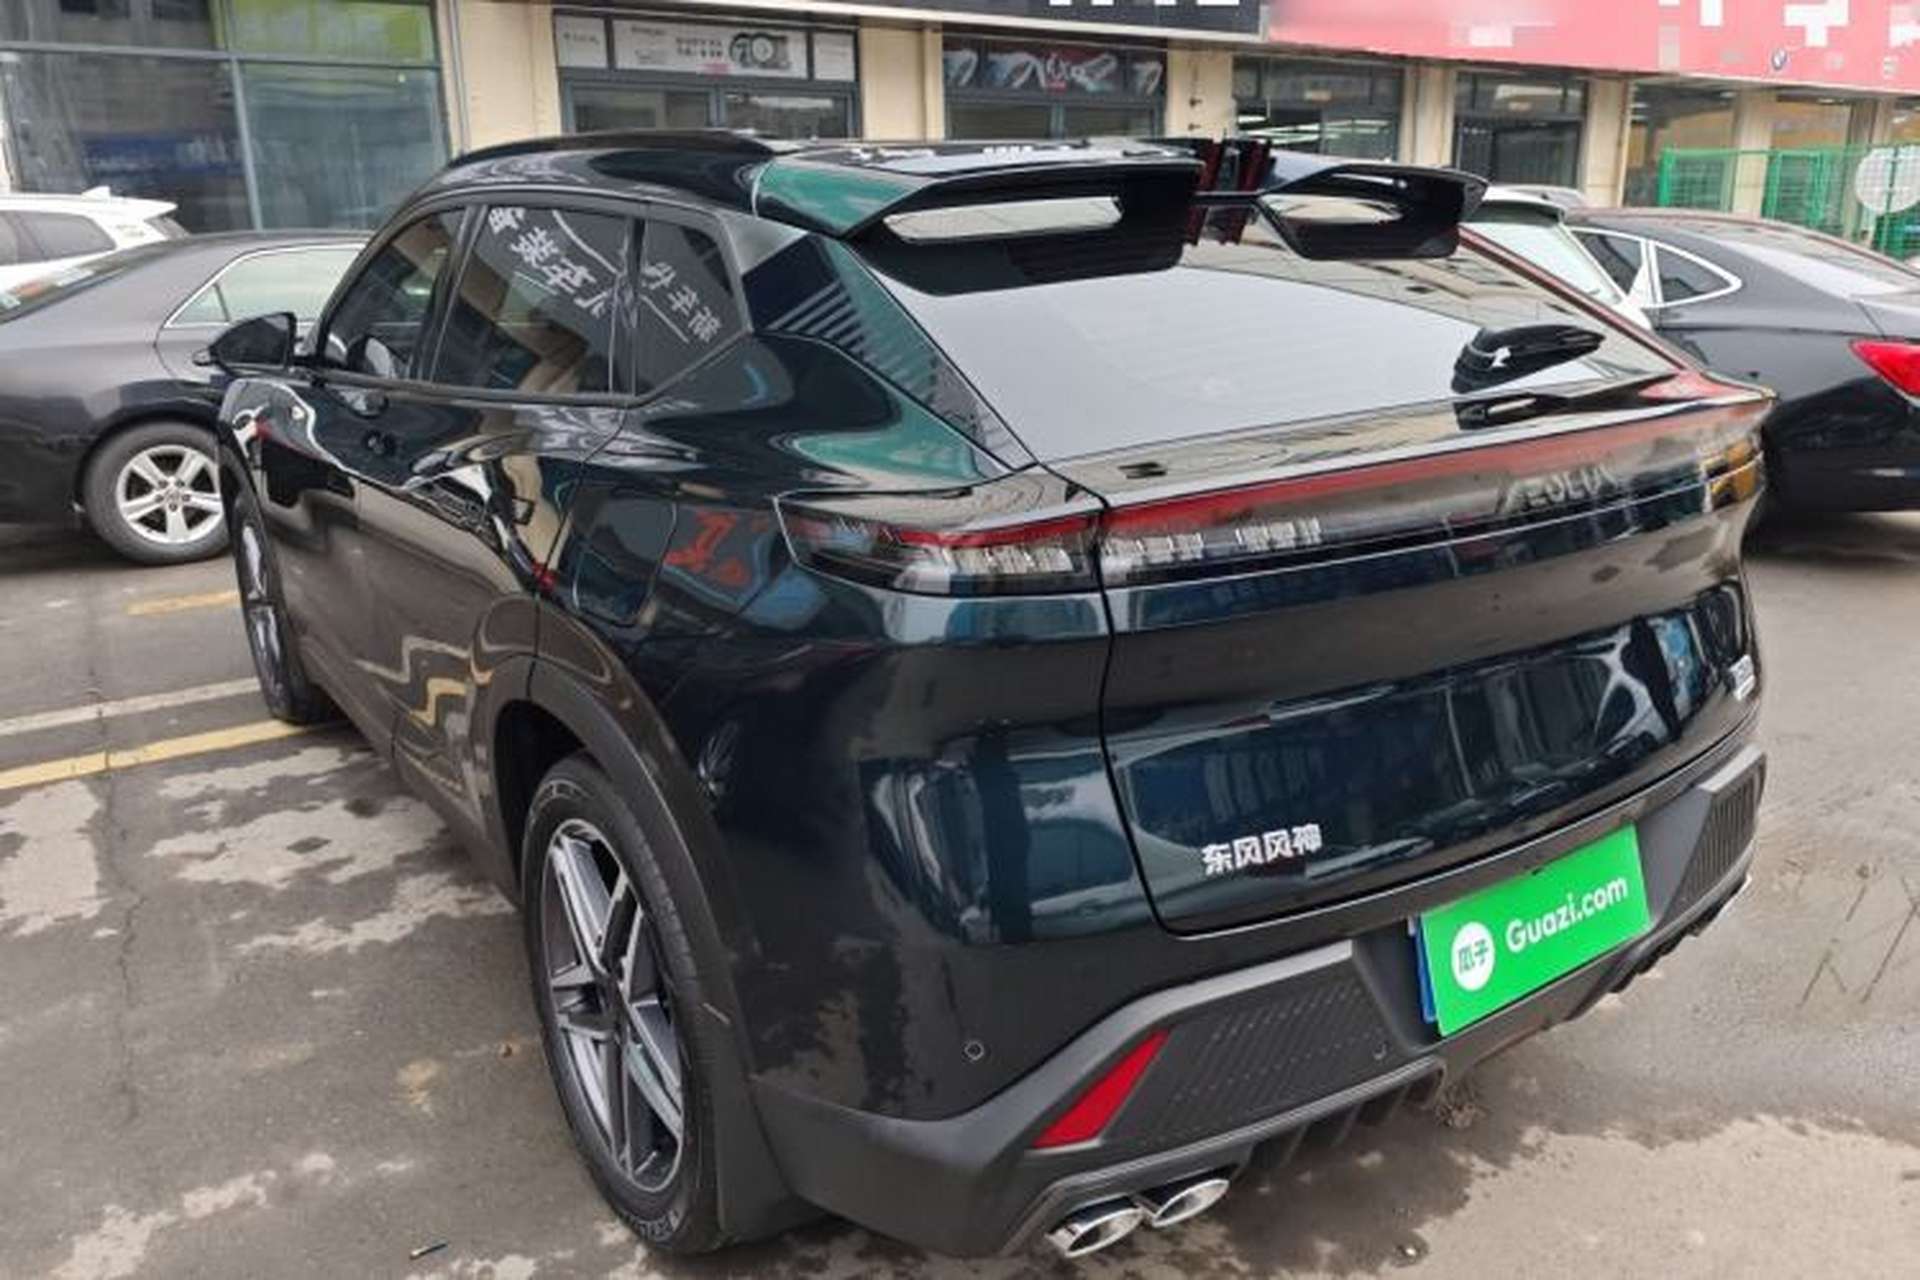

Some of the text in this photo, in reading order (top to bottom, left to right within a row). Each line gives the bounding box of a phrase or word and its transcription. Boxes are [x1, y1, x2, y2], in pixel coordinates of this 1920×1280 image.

[1202, 823, 1322, 876] 东风风神
[1456, 877, 1628, 974] 瓜子 Guazi.com
